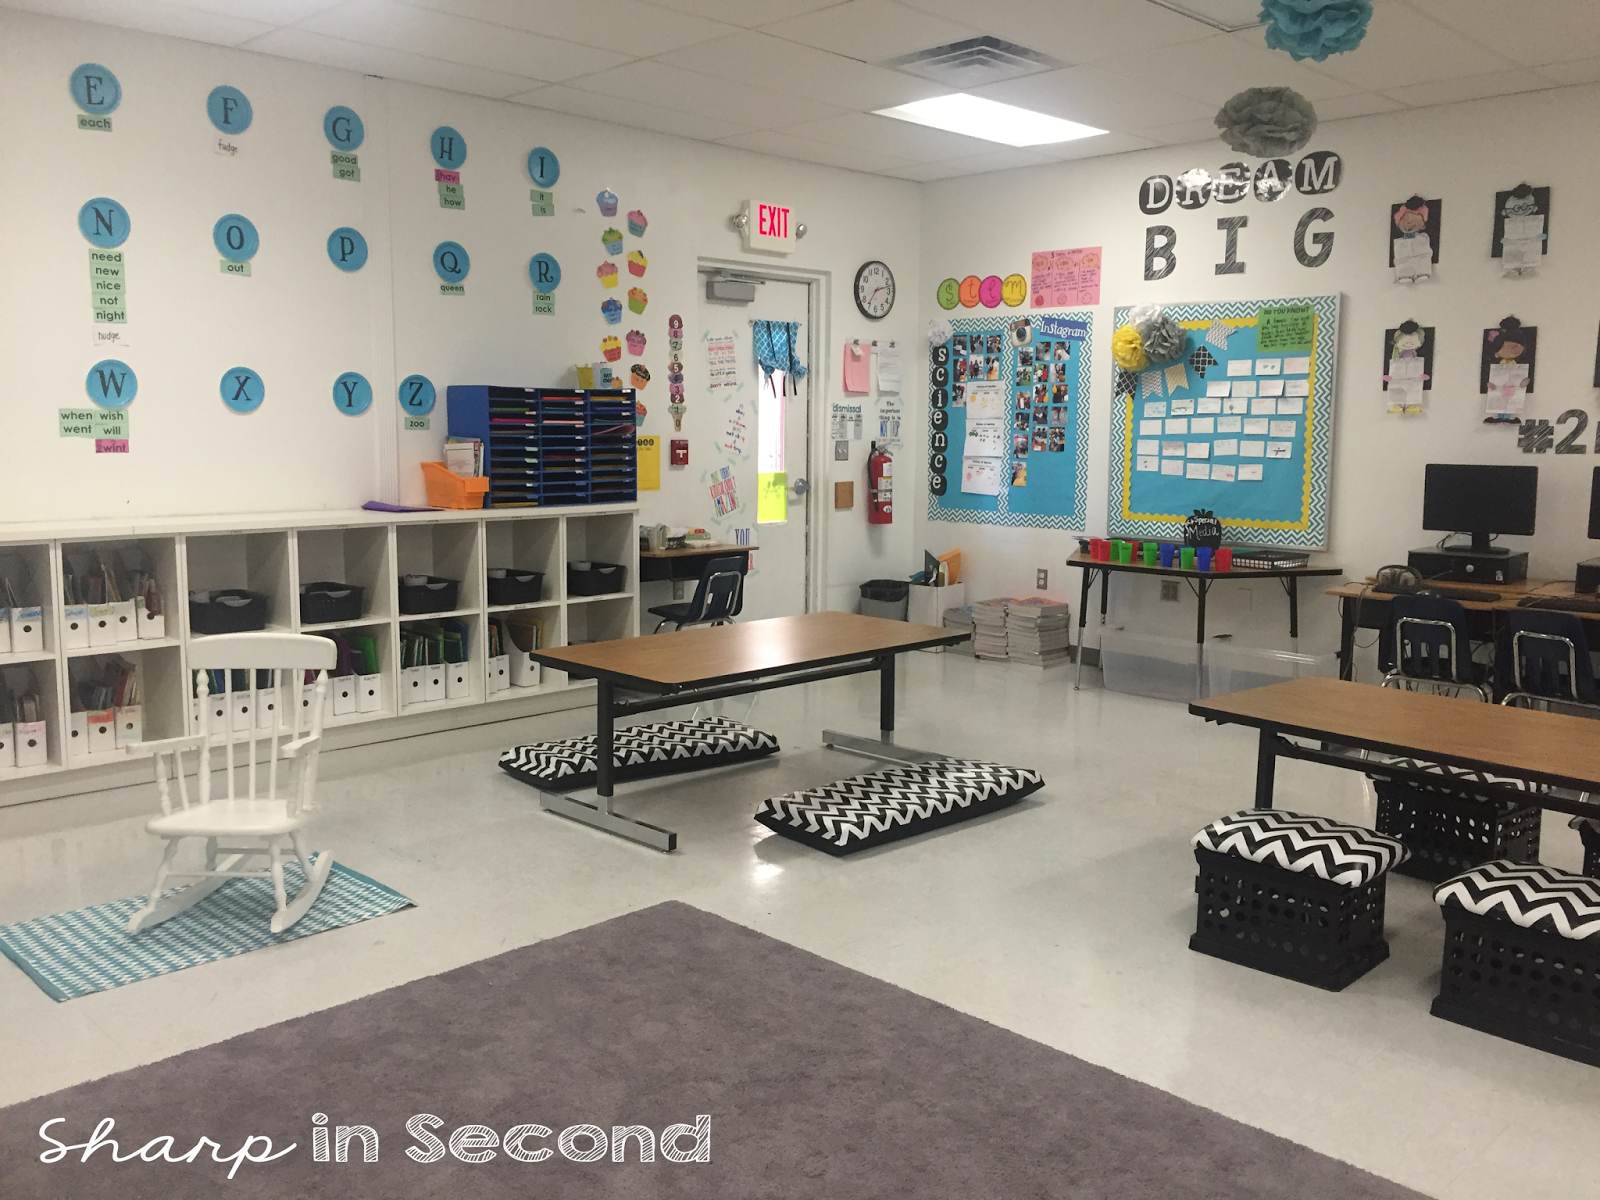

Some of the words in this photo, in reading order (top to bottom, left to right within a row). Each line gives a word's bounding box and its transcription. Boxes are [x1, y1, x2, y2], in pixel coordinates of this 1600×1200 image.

[84, 75, 105, 106] E
[221, 97, 238, 125] F
[80, 118, 111, 129] each
[332, 116, 352, 143] G
[218, 138, 238, 156] fudge
[439, 136, 454, 161] H
[332, 154, 357, 165] good
[339, 167, 355, 179] got
[1145, 156, 1339, 209] DREAM
[446, 185, 457, 194] he
[444, 197, 462, 206] how
[91, 206, 115, 236] N
[758, 204, 790, 239] EXIT
[226, 225, 245, 250] O
[339, 236, 355, 262] P
[1144, 207, 1334, 281] BIG
[91, 252, 122, 263] need
[440, 251, 462, 274] Q
[95, 266, 120, 277] new
[227, 264, 245, 273] out
[536, 260, 554, 284] R
[96, 280, 122, 291] nice
[440, 284, 465, 293] queen
[99, 296, 119, 306] not
[536, 293, 551, 302] rain
[535, 304, 553, 313] rock
[96, 310, 126, 322] night
[1040, 320, 1086, 339] Instagram
[97, 331, 121, 343] nudge
[95, 368, 127, 398] W
[231, 375, 252, 401] X
[341, 381, 358, 407] Y
[408, 382, 424, 407] Z
[832, 403, 862, 413] dismissal
[61, 411, 93, 421] when
[99, 411, 124, 421] wish
[63, 424, 92, 434] went
[409, 420, 425, 428] zoo
[102, 426, 121, 435] will
[1517, 408, 1600, 454] #2
[1188, 524, 1220, 541] Media
